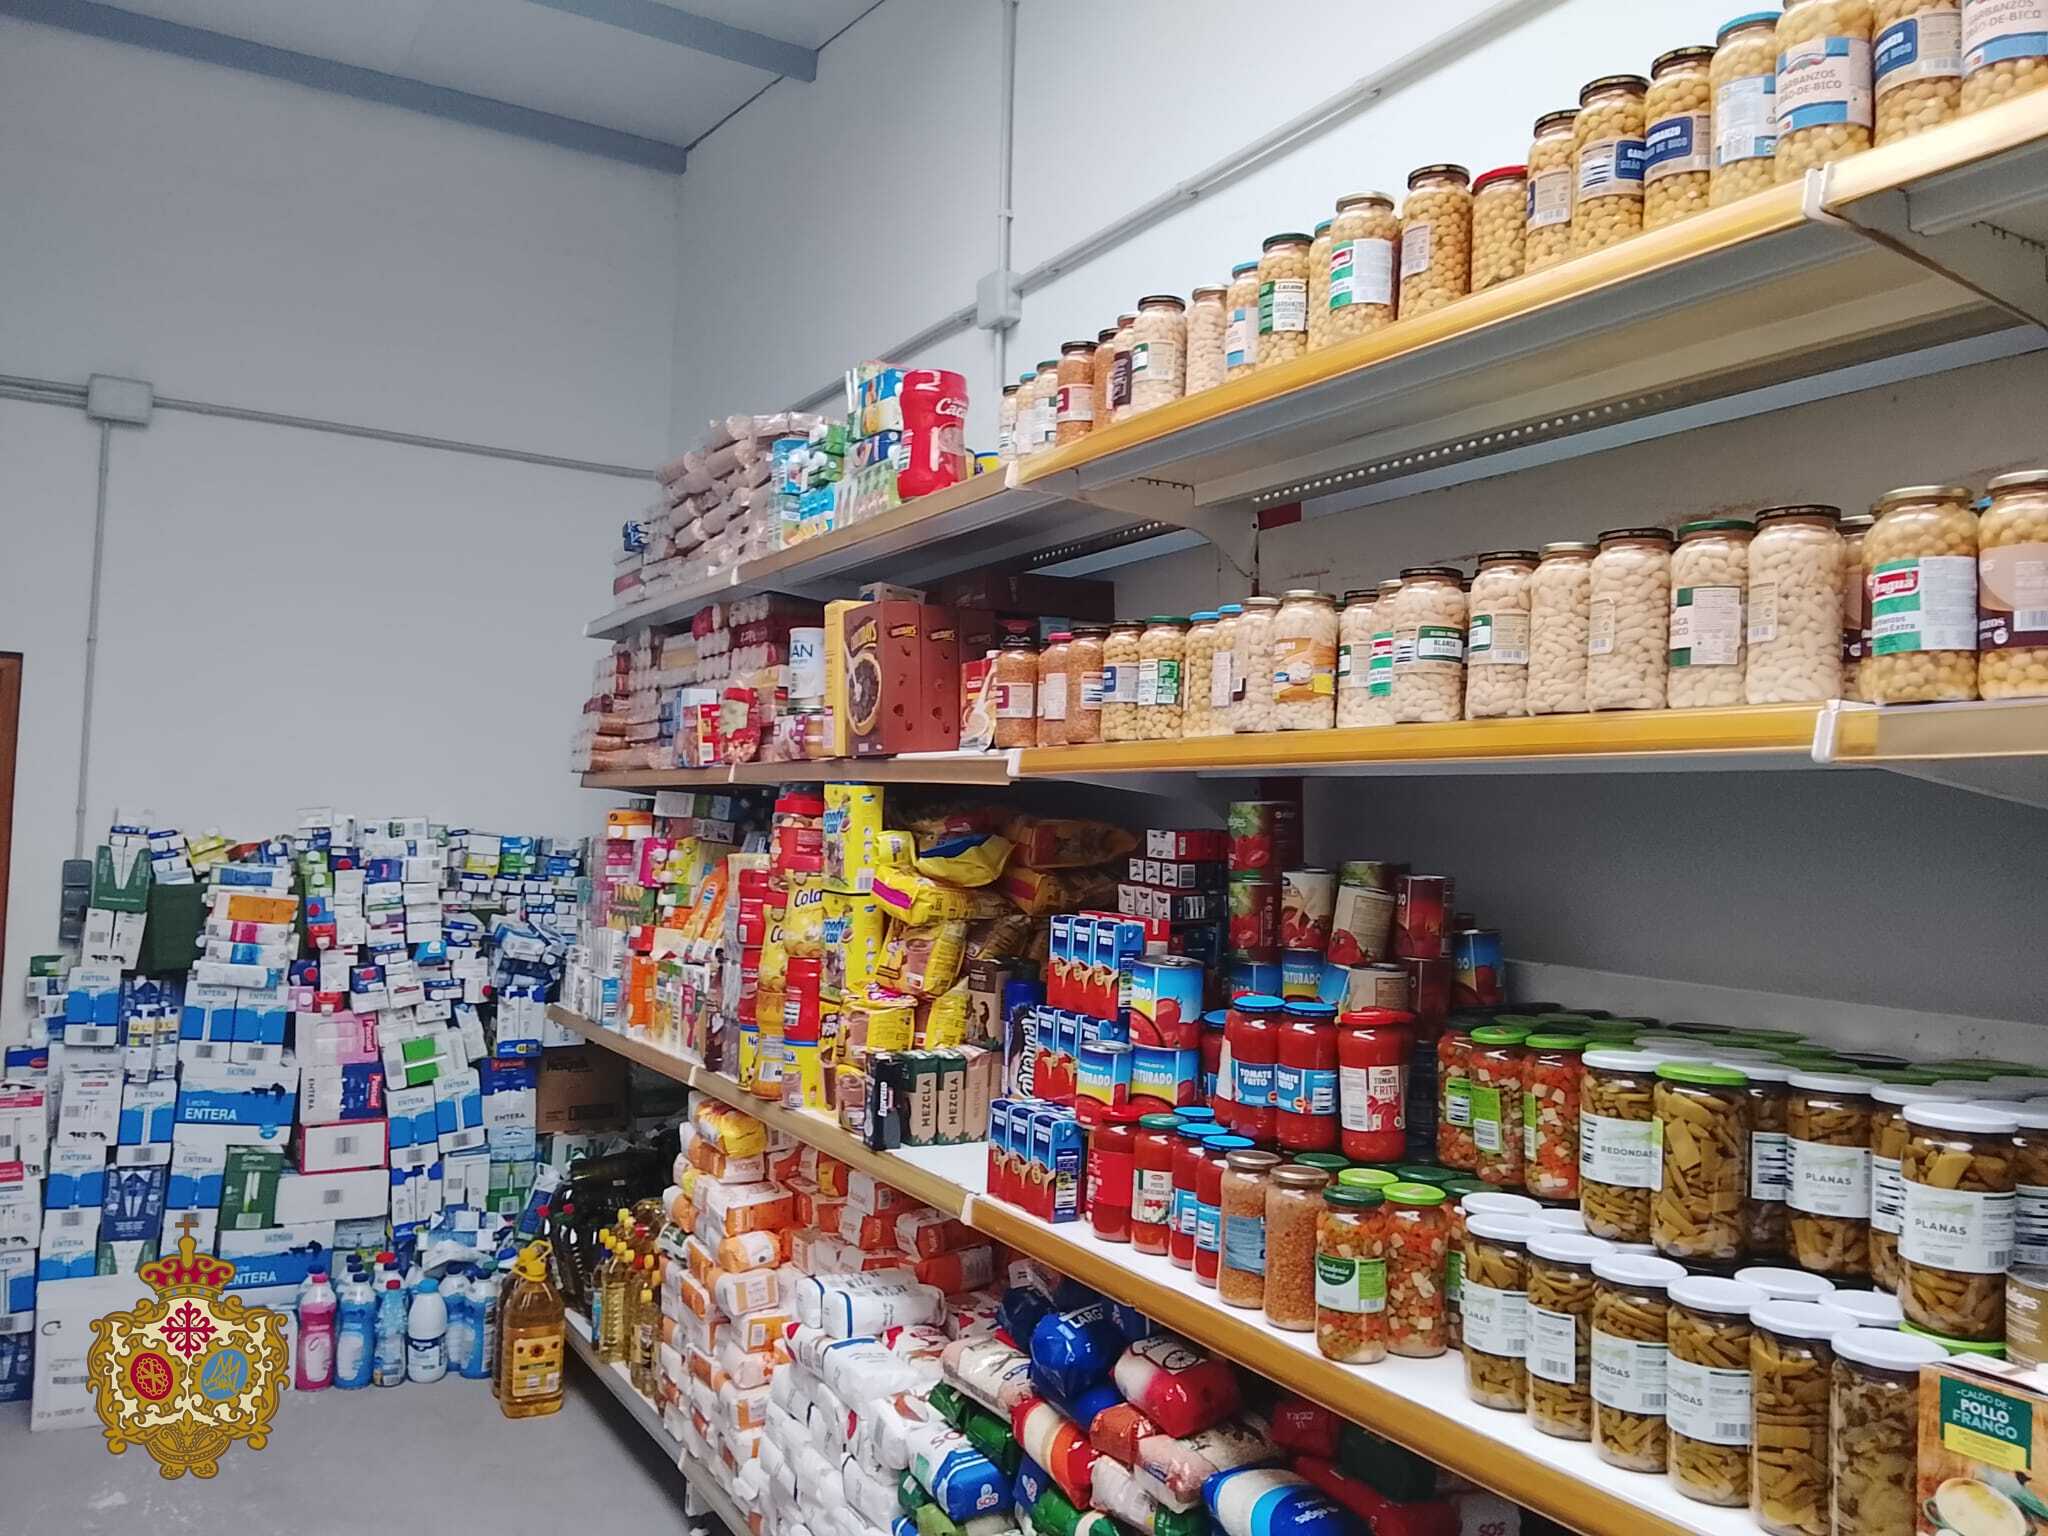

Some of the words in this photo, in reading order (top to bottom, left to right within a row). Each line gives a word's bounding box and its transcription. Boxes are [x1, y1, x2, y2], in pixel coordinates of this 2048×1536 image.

[795, 888, 823, 908] Cola
[771, 924, 785, 943] Co
[1240, 1068, 1273, 1080] TOMATE
[1243, 1076, 1268, 1087] FRITO
[308, 1078, 316, 1111] ENTERA
[921, 1079, 931, 1127] MEZCLA
[948, 1077, 958, 1125] MEZCLA
[184, 1107, 238, 1121] ENTERA
[493, 1112, 526, 1121] ENTERA
[60, 1153, 93, 1161] ENTERA
[182, 1155, 213, 1164] ENTERA
[1805, 1171, 1853, 1187] PLANAS
[1914, 1218, 1968, 1236] PLANAS
[1960, 1388, 1994, 1404] CALDO
[1994, 1397, 2008, 1410] DE
[1960, 1398, 2010, 1425] POLLO
[1952, 1408, 2018, 1440] FRANGO
[976, 1493, 999, 1510] SOS
